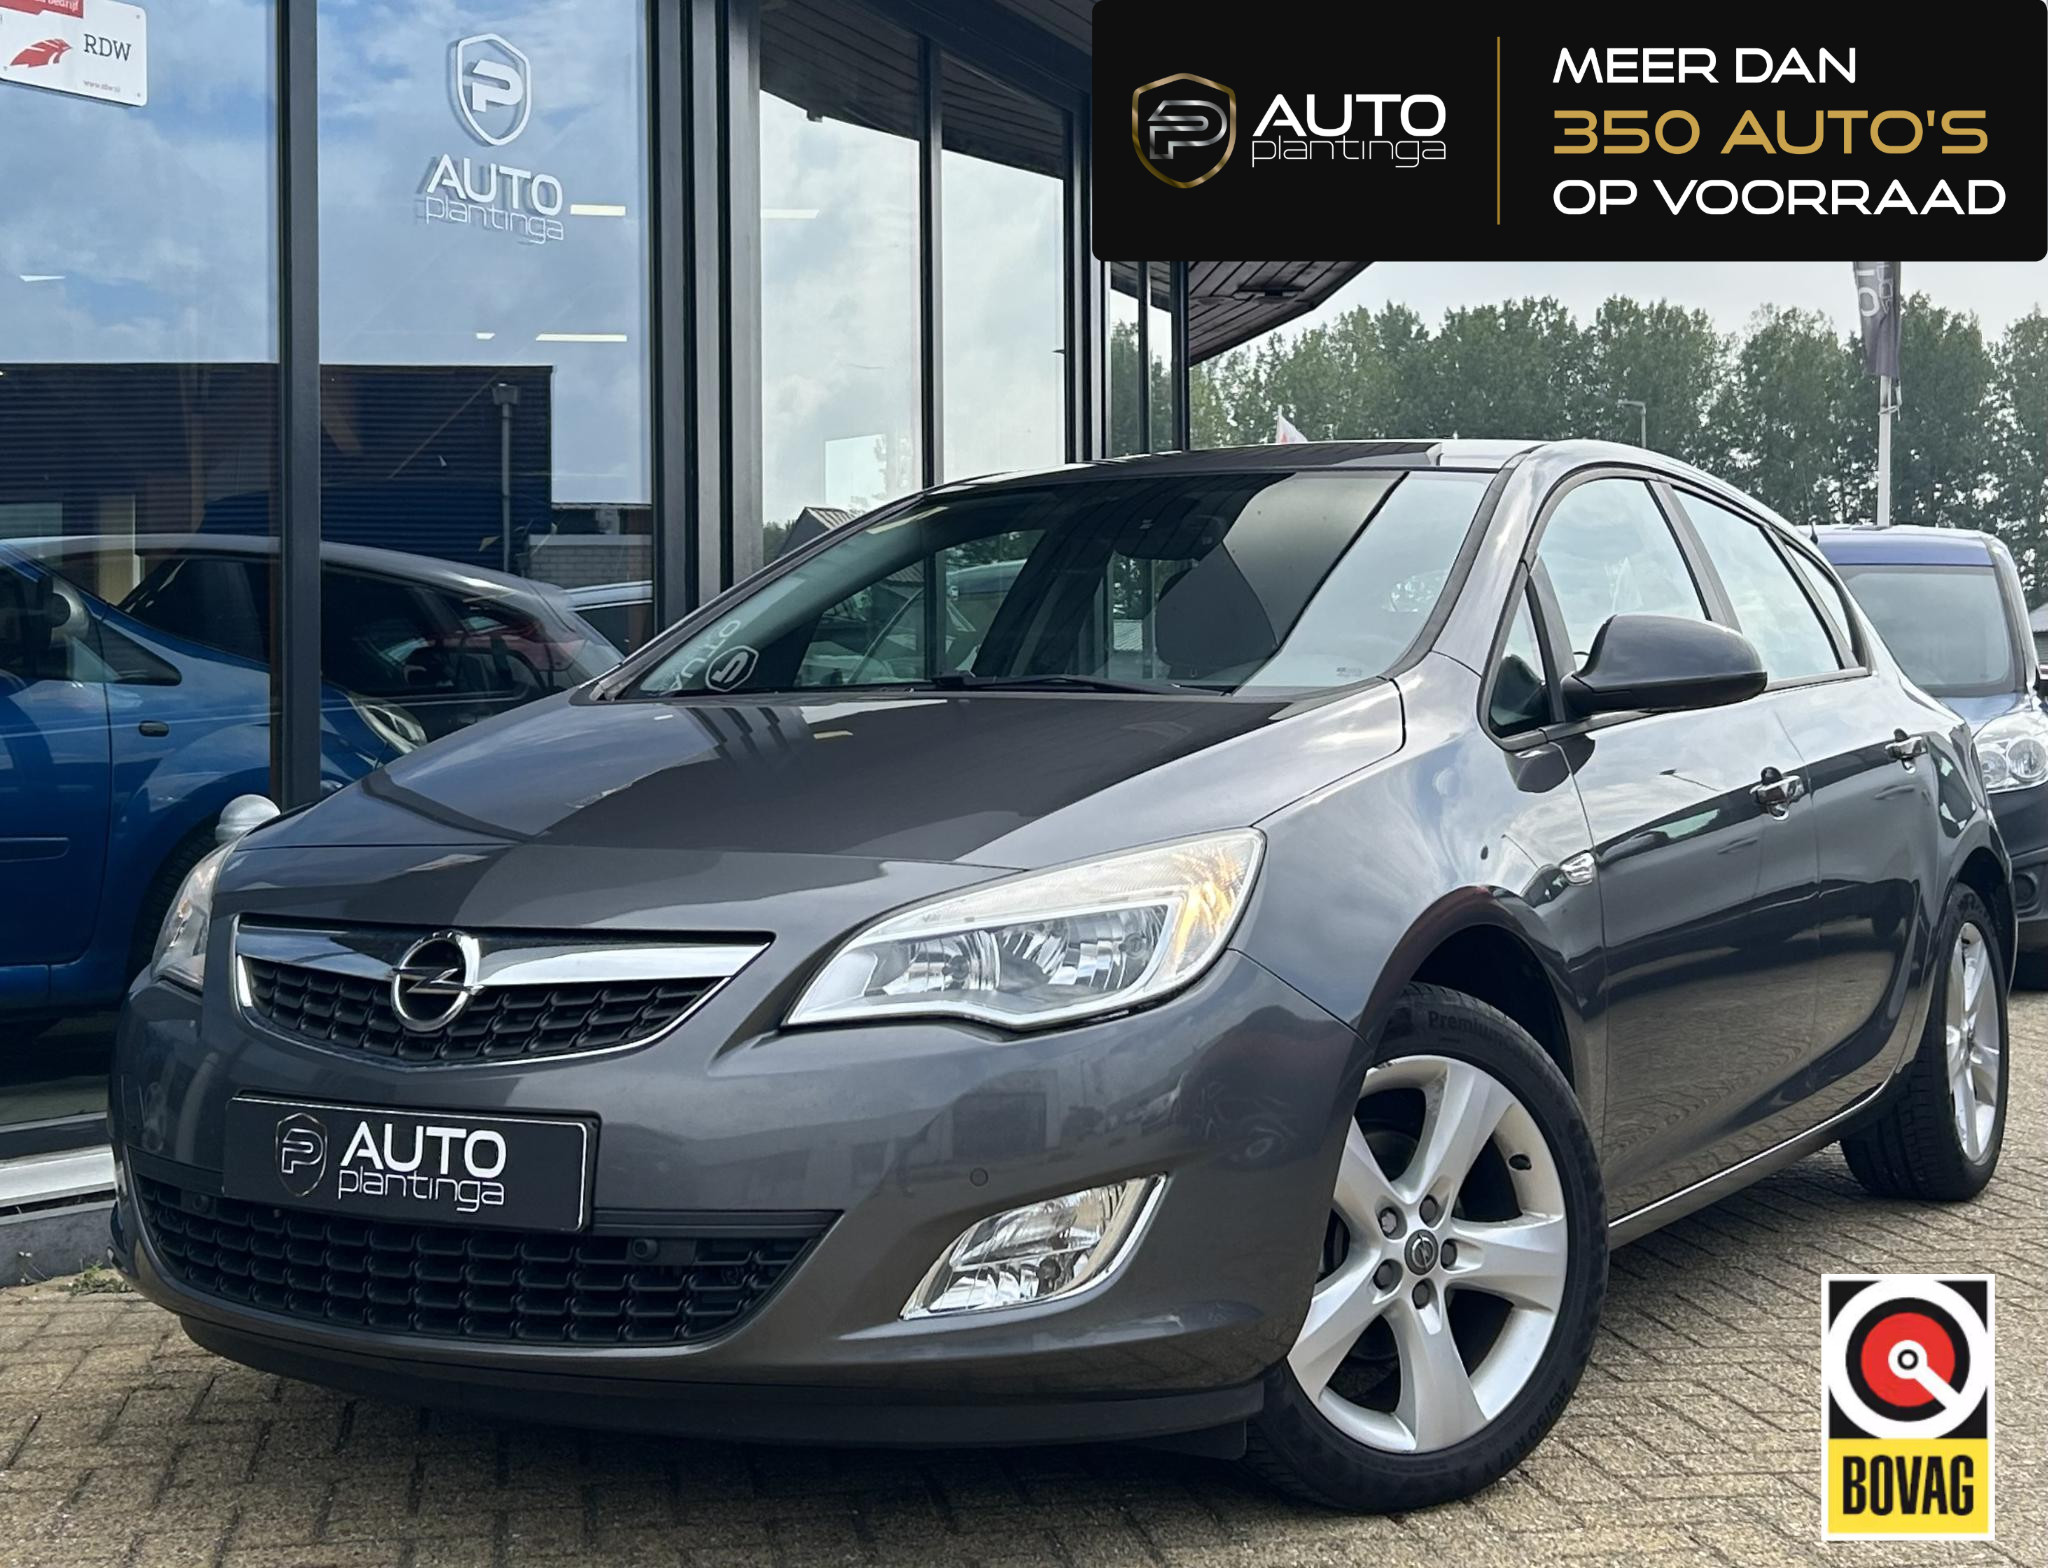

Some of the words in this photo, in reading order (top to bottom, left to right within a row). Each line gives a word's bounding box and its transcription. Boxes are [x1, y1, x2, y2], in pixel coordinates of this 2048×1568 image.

[83, 33, 132, 62] RDW
[427, 153, 563, 216] AUTO
[426, 195, 564, 245] plantinga
[340, 1120, 507, 1179] AUTO
[338, 1166, 505, 1213] plantinga
